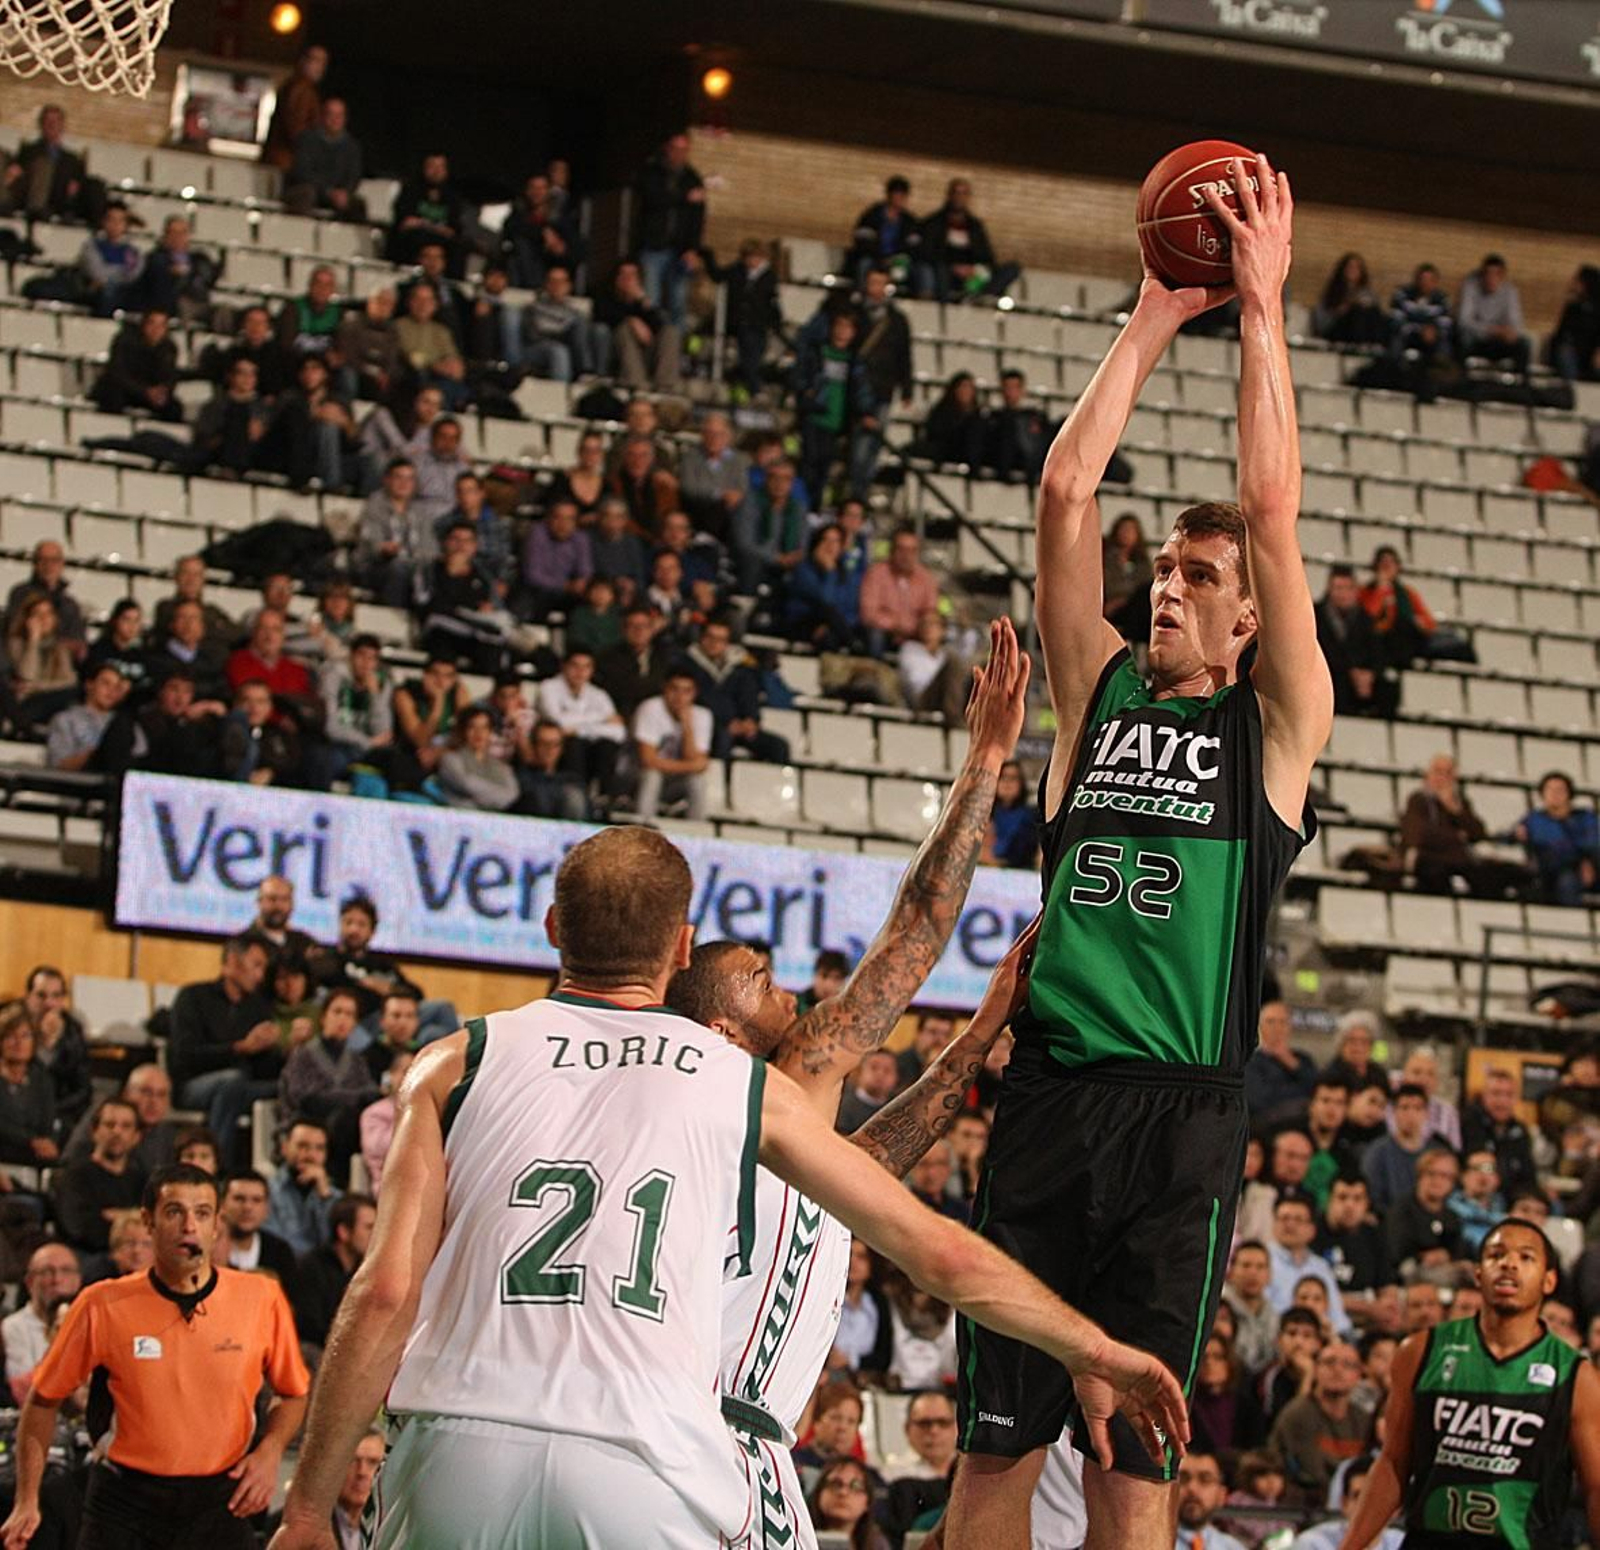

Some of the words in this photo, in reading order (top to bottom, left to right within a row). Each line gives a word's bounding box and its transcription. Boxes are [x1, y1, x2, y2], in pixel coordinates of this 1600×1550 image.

[1085, 770, 1198, 794] mutua
[152, 799, 331, 898] Veri
[408, 830, 570, 920] Ver
[1070, 841, 1182, 919] 52
[547, 1036, 703, 1074] ZORIC
[501, 1159, 675, 1323] 21
[1433, 1397, 1545, 1447] FIATC
[1447, 1486, 1501, 1534] 12
